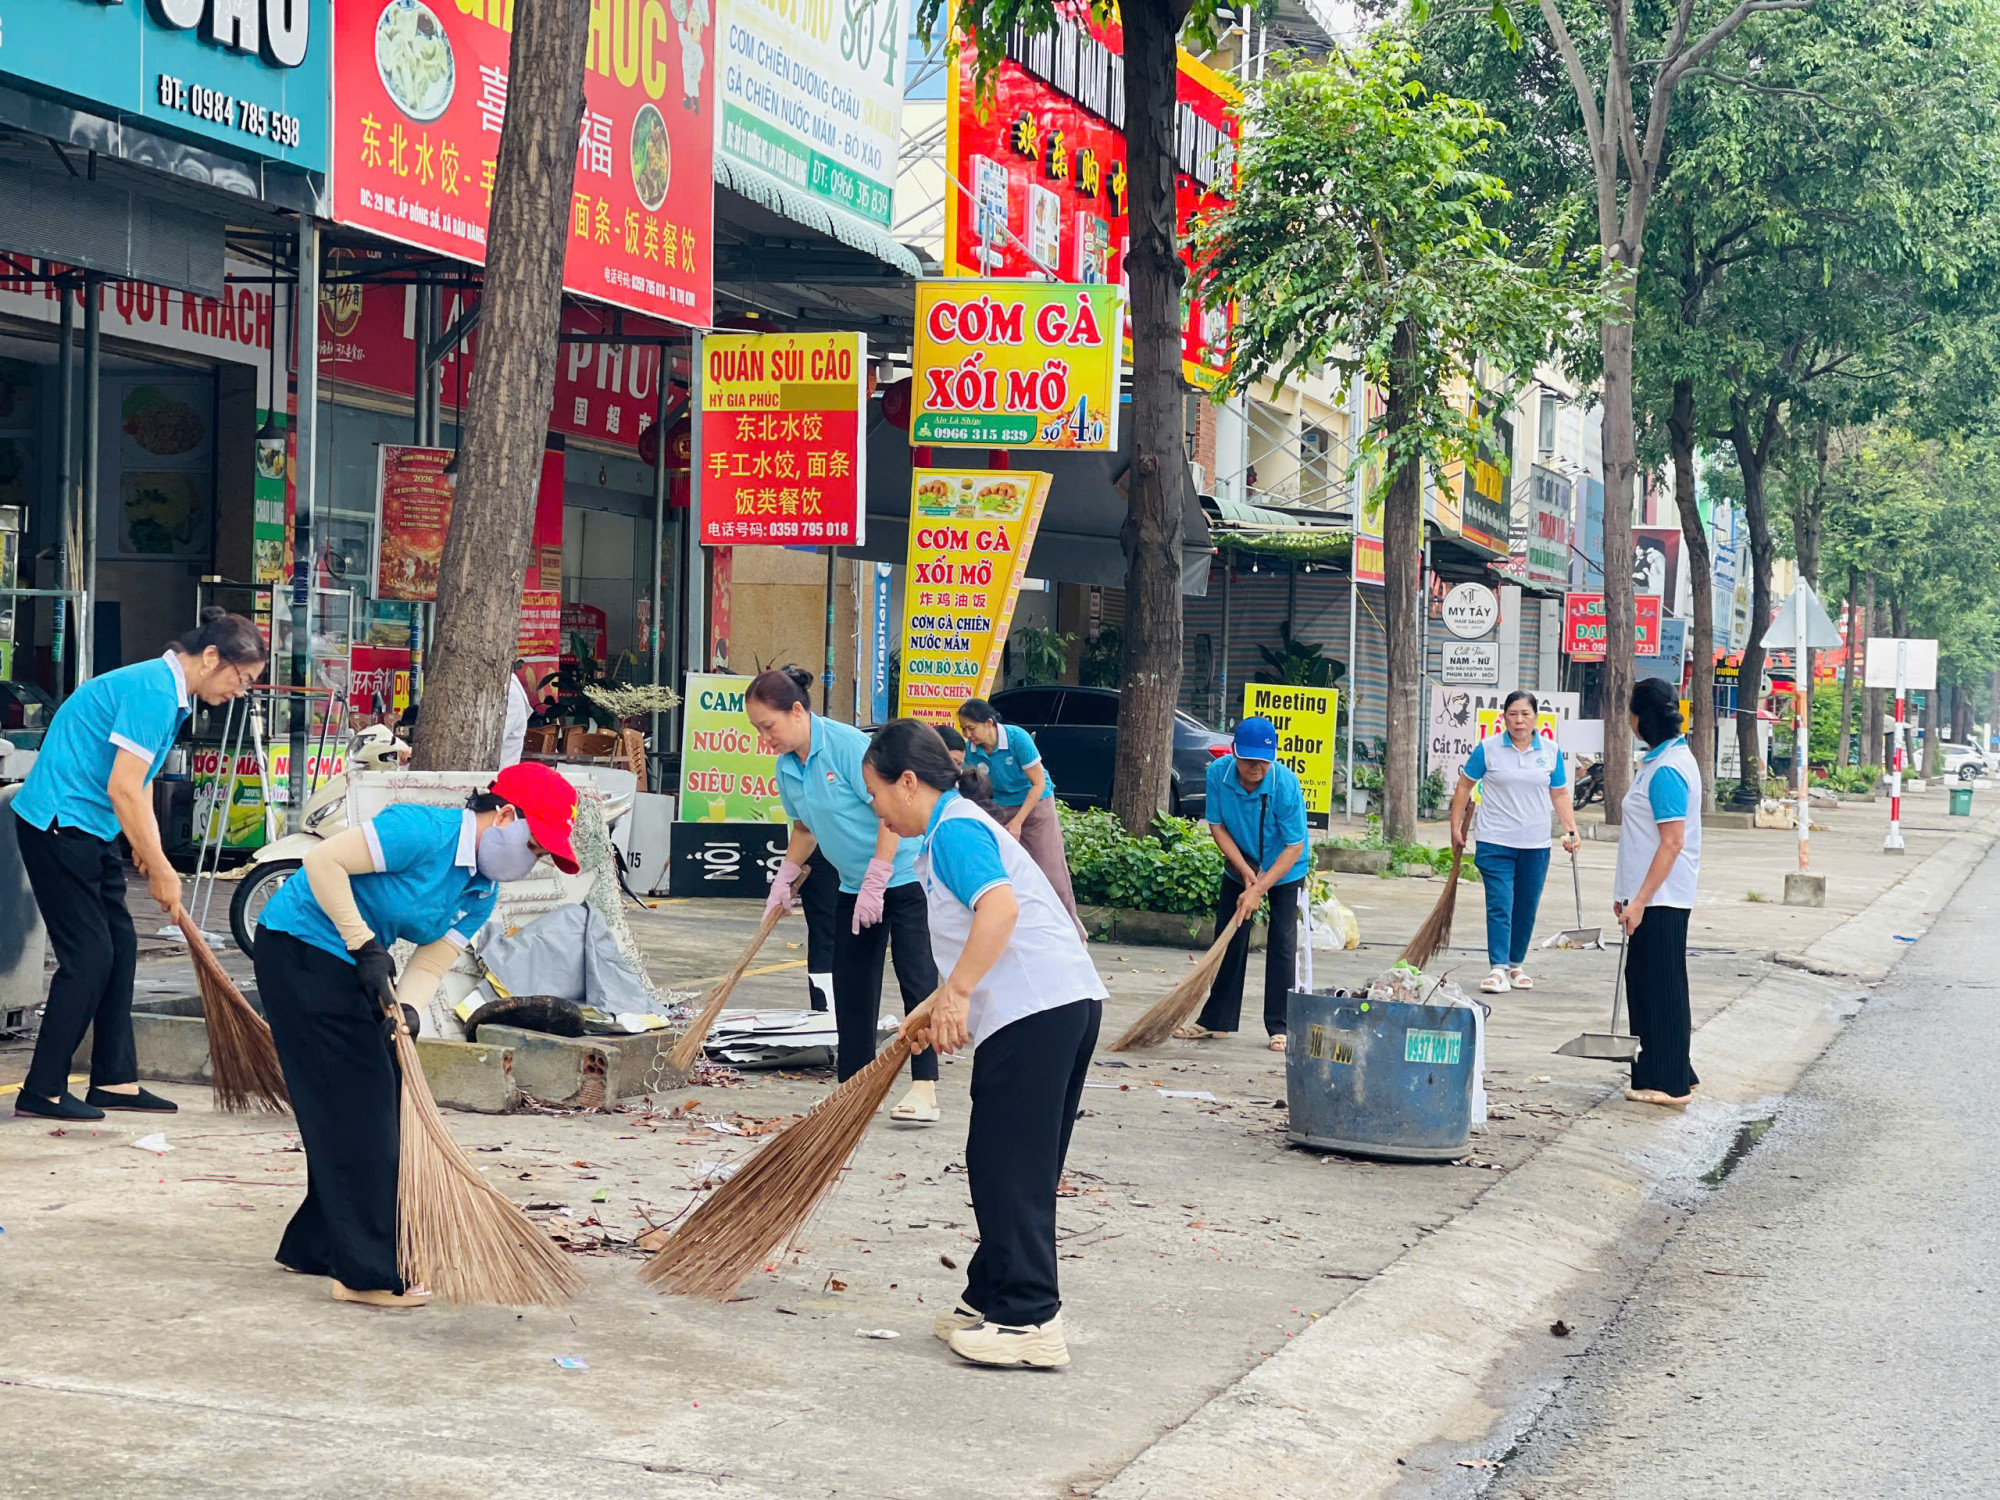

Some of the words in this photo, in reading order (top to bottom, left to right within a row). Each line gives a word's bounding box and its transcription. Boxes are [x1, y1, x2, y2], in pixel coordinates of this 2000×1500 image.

[729, 24, 754, 62] CƠM
[757, 45, 790, 82] CHIÊN
[879, 0, 898, 88] 4
[160, 73, 187, 110] ĐT:
[191, 83, 235, 127] 0984
[238, 100, 267, 137] 785
[271, 112, 300, 148] 598
[746, 80, 779, 117] CHIÊN
[813, 159, 828, 188] ĐT:
[831, 169, 854, 200] 0966
[856, 181, 869, 208] 315
[871, 188, 888, 216] 839
[374, 193, 383, 212] 29
[929, 296, 1025, 344] CƠM
[1037, 294, 1102, 345] GÀ
[710, 344, 764, 385] QUÁN
[771, 339, 804, 382] SỦI
[811, 338, 851, 381] CẢO
[925, 352, 999, 409] XỐI
[1006, 360, 1067, 411] MỠ
[727, 394, 746, 407] GIA
[749, 390, 779, 407] PHÚC
[736, 413, 824, 442] 东北水饺
[934, 428, 968, 440] 0966
[972, 428, 998, 440] 315
[1001, 429, 1028, 441] 839
[806, 450, 850, 478] 面条
[412, 474, 434, 484] 2026
[735, 487, 822, 516] 饭类餐饮
[708, 521, 768, 537] 电话号码:
[769, 522, 799, 537] 0359
[801, 522, 823, 536] 795
[825, 522, 849, 536] 018
[917, 525, 969, 551] CƠM
[976, 525, 1012, 552] GÀ
[914, 555, 954, 584] XỐI
[959, 559, 993, 586] MỠ
[919, 592, 987, 608] 炸鸡油饭
[1448, 607, 1466, 616] MY
[1470, 605, 1491, 617] TÂY
[911, 616, 935, 629] CƠM
[937, 614, 953, 630] GÀ
[956, 614, 991, 631] CHIÊN
[875, 582, 887, 693] vinaphone
[910, 635, 942, 650] NƯỚC
[943, 632, 970, 651] MẮM
[1572, 642, 1589, 651] LH:
[1637, 644, 1655, 653] 733
[908, 658, 935, 674] CƠM
[936, 657, 951, 675] BÒ
[953, 657, 979, 676] XÀO
[1450, 657, 1470, 665] NAM
[1477, 657, 1491, 665] NỮ
[700, 691, 744, 712] CAM
[1255, 690, 1327, 715] Meeting
[693, 728, 751, 753] NƯỚC
[1276, 734, 1323, 755] Labor
[1433, 734, 1451, 754] Cắt
[1454, 737, 1473, 755] Tóc
[193, 750, 229, 775] ƯỚC
[687, 768, 735, 794] SIÊU
[740, 777, 780, 802] SẠC
